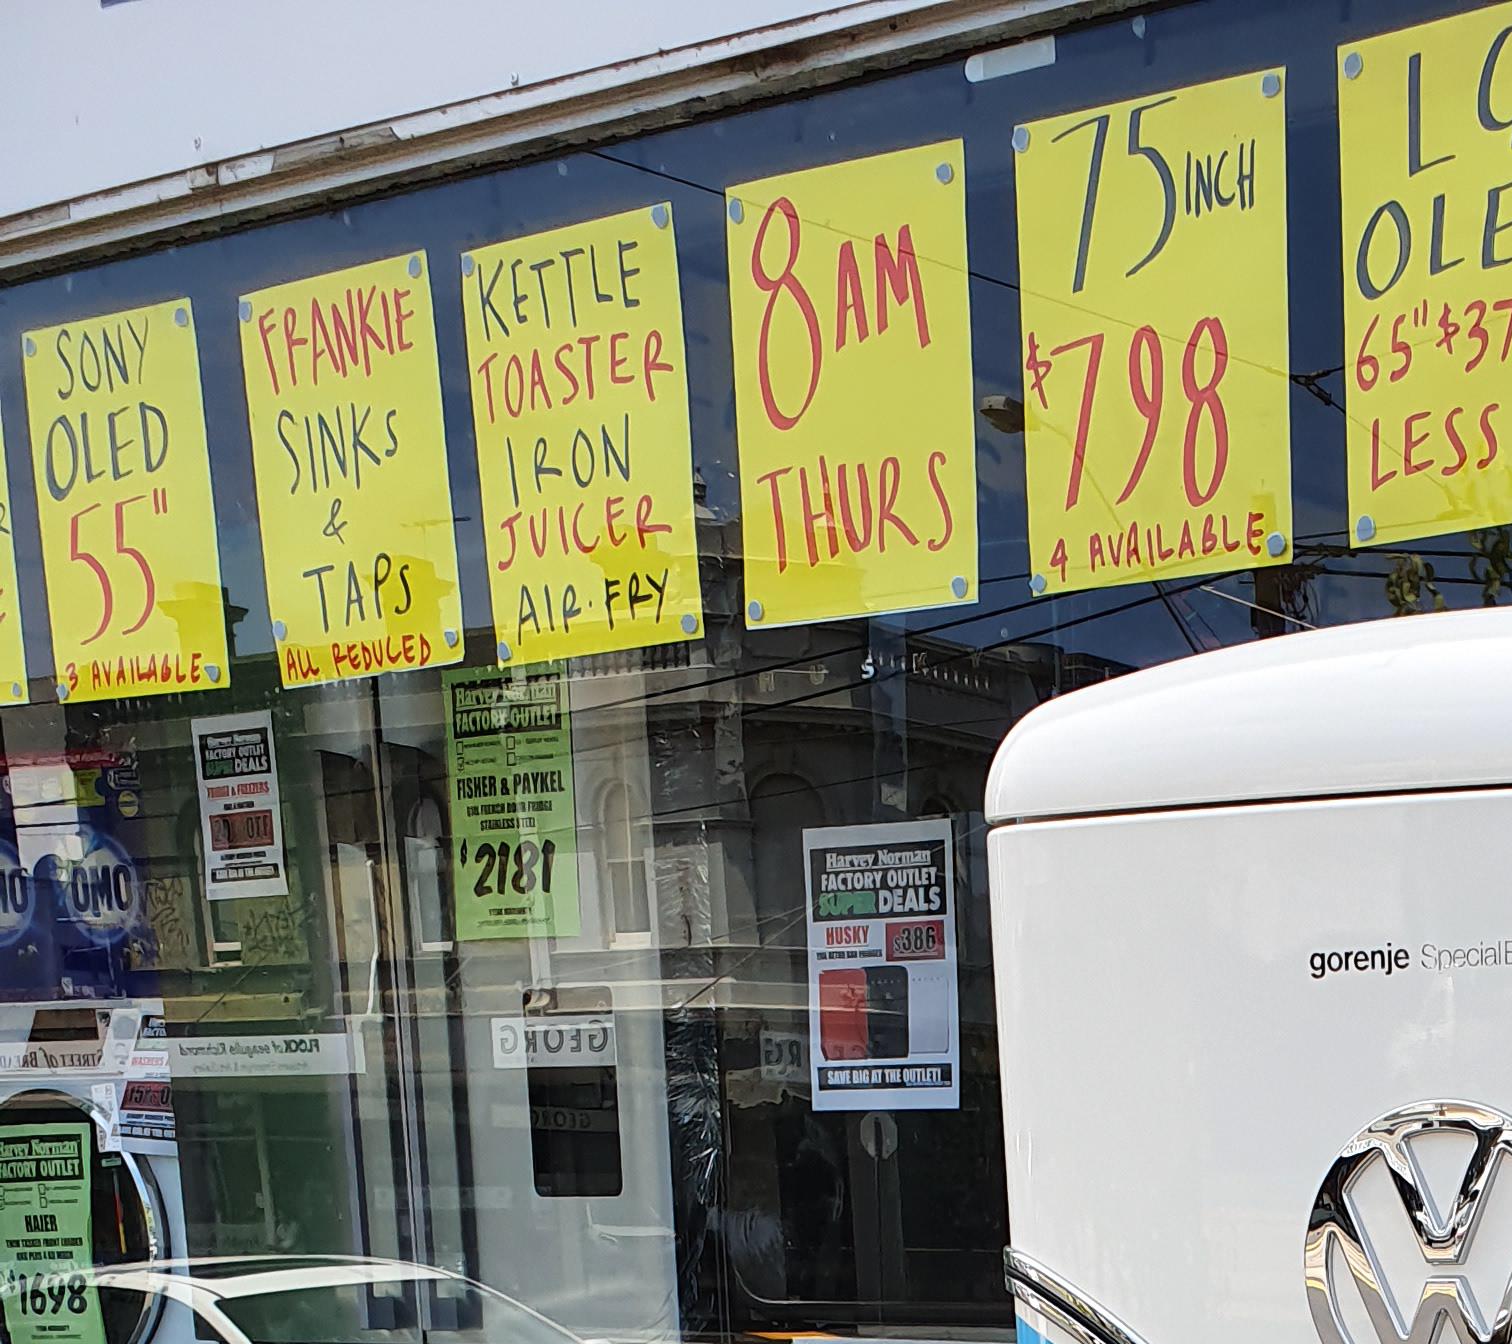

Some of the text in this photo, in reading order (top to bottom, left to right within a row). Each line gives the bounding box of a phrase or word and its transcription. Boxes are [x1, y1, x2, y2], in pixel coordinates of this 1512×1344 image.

[1051, 96, 1256, 294] 75 INCH
[476, 239, 641, 343] KETTLE
[56, 317, 149, 399] SONY
[258, 284, 414, 396] FRANKIE
[476, 328, 674, 426] TOASTER
[1024, 316, 1228, 512] $798
[45, 402, 169, 501] OLED
[276, 402, 398, 496] SINKS
[507, 412, 632, 508] IRON
[1371, 402, 1500, 492] LESS
[322, 499, 348, 545] &
[496, 494, 673, 573] JUICER
[755, 451, 953, 574] THURS
[70, 488, 167, 646] 55"
[1049, 511, 1266, 582] 4 AVAILABLE
[302, 551, 411, 634] TAPS
[64, 652, 204, 691] 3 AVAILABLE
[285, 630, 432, 676] ALL REDUCED
[511, 703, 557, 729] OUTLET
[234, 756, 268, 773] DEALS
[457, 770, 565, 800] FISHER & PAYKEL
[821, 867, 937, 891] FACTORY OUTLET
[826, 849, 931, 869] Harvey Norman
[72, 864, 131, 912] OMO
[819, 886, 940, 916] SUPER DEALS
[826, 925, 936, 952] HUSKY $386
[1310, 943, 1410, 979] gorenje
[828, 1070, 850, 1085] SAVE
[871, 1069, 883, 1083] AT
[885, 1069, 901, 1083] THE
[31, 1139, 78, 1155] Norman
[41, 1160, 80, 1177] OUTLET
[25, 1215, 58, 1233] HAIER
